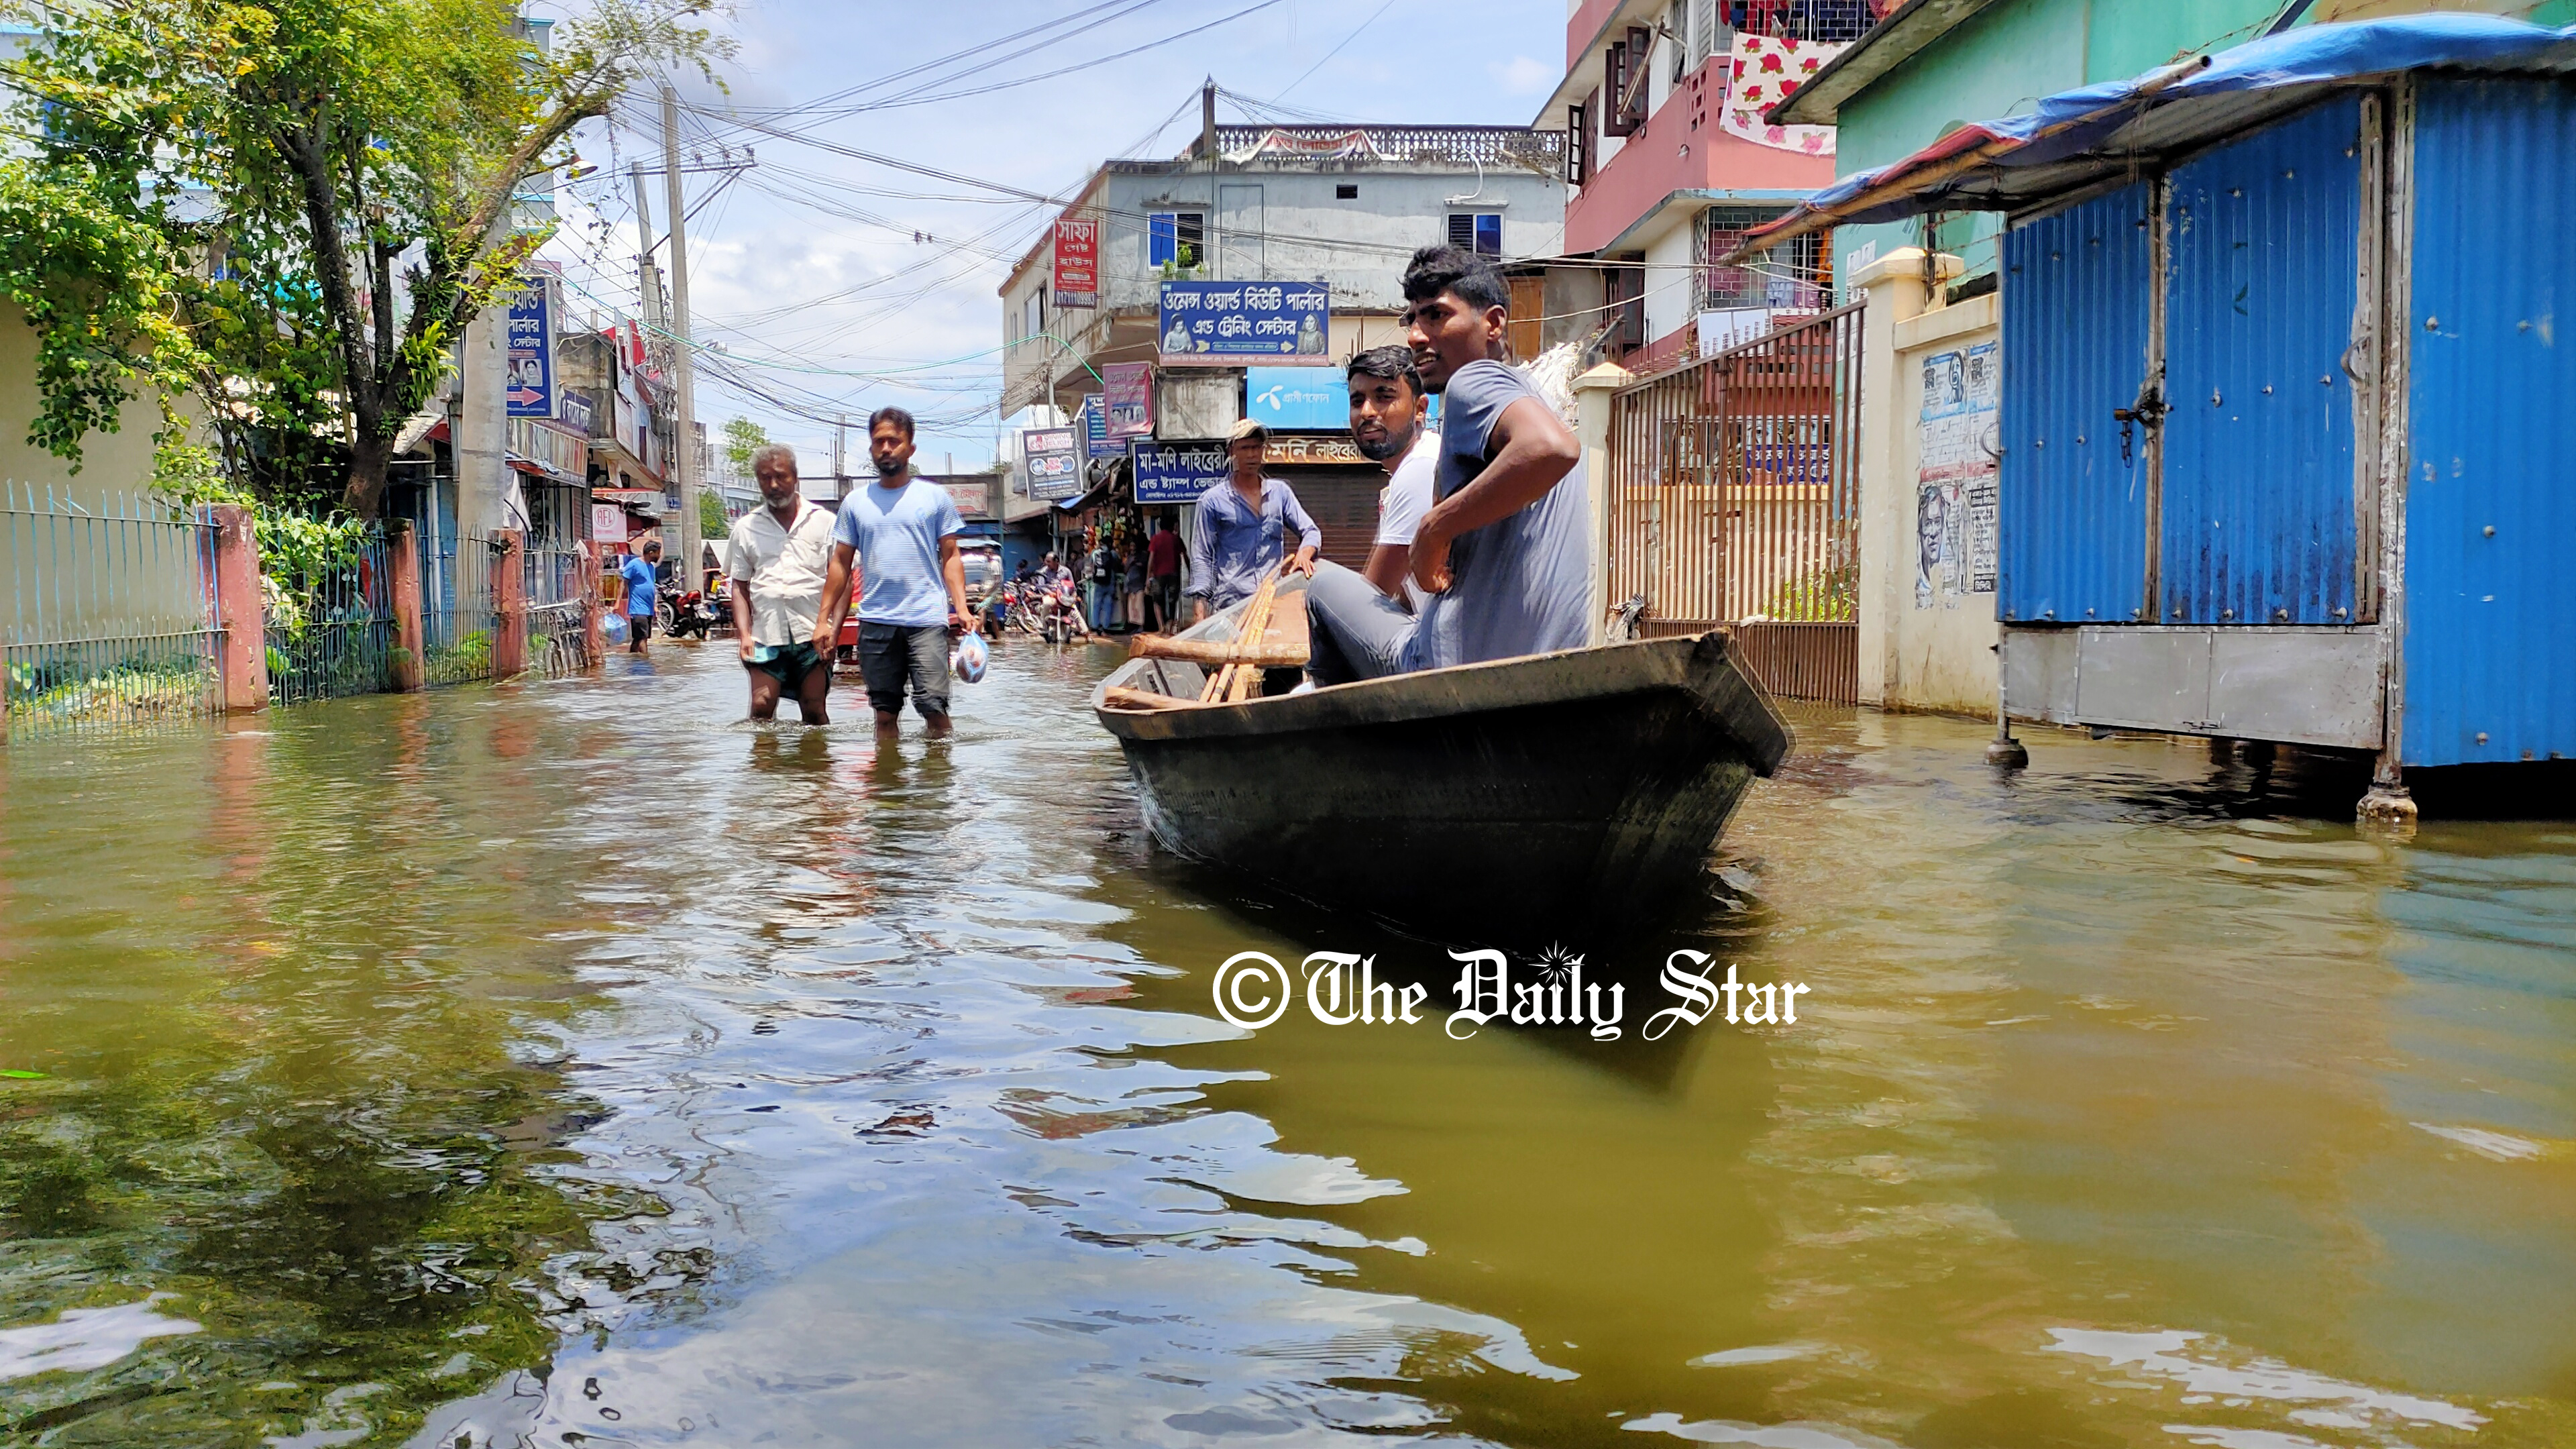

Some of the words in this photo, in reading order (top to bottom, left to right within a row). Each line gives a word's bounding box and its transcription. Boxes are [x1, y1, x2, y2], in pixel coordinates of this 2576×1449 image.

[1058, 220, 1095, 242] সাফা
[1163, 291, 1201, 311] ওমেন্স
[1244, 286, 1282, 311] বিউটি
[1286, 288, 1325, 311] পার্লার
[1218, 315, 1252, 337] ট্রেনিং
[1255, 317, 1297, 335] সেন্টার
